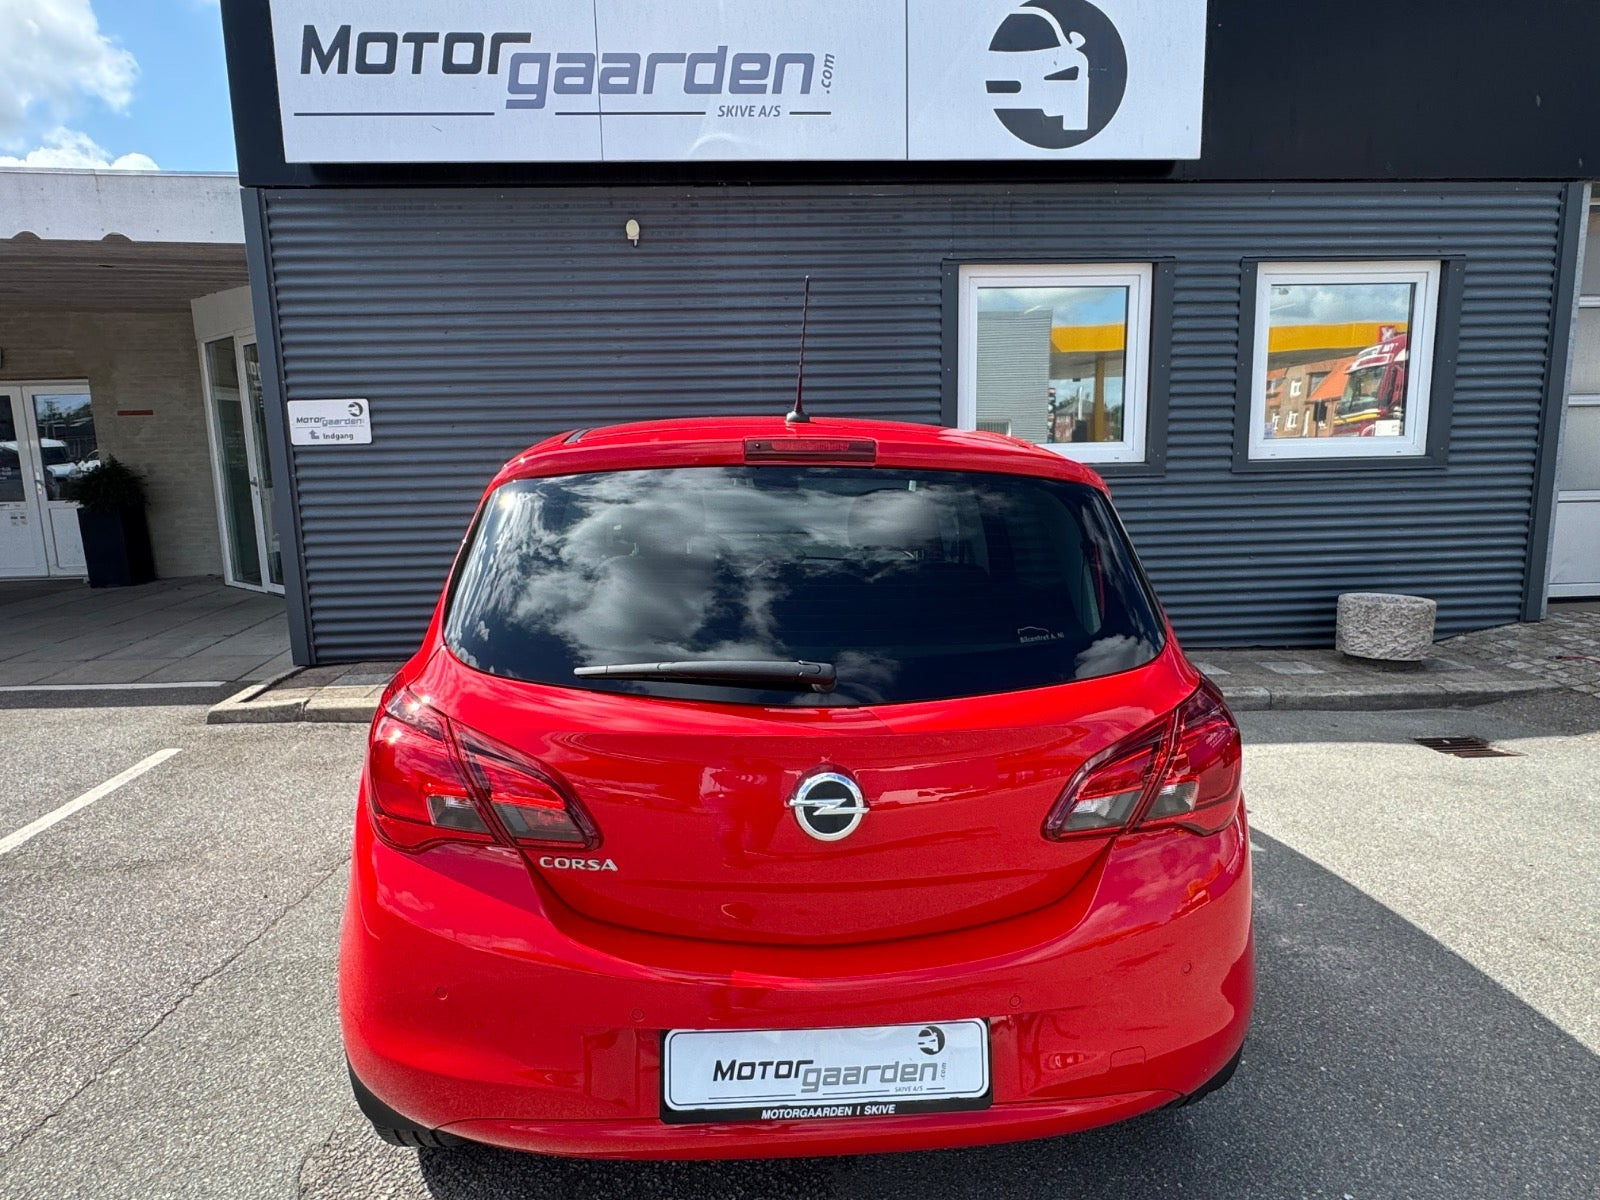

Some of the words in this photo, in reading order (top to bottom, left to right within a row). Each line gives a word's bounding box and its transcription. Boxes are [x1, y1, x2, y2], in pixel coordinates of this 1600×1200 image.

[717, 105, 756, 118] SKIVE
[758, 105, 782, 118] A/S
[539, 856, 618, 871] CORSA
[761, 1106, 852, 1119] MOTORGAARDEN
[864, 1104, 896, 1115] SKIVE
